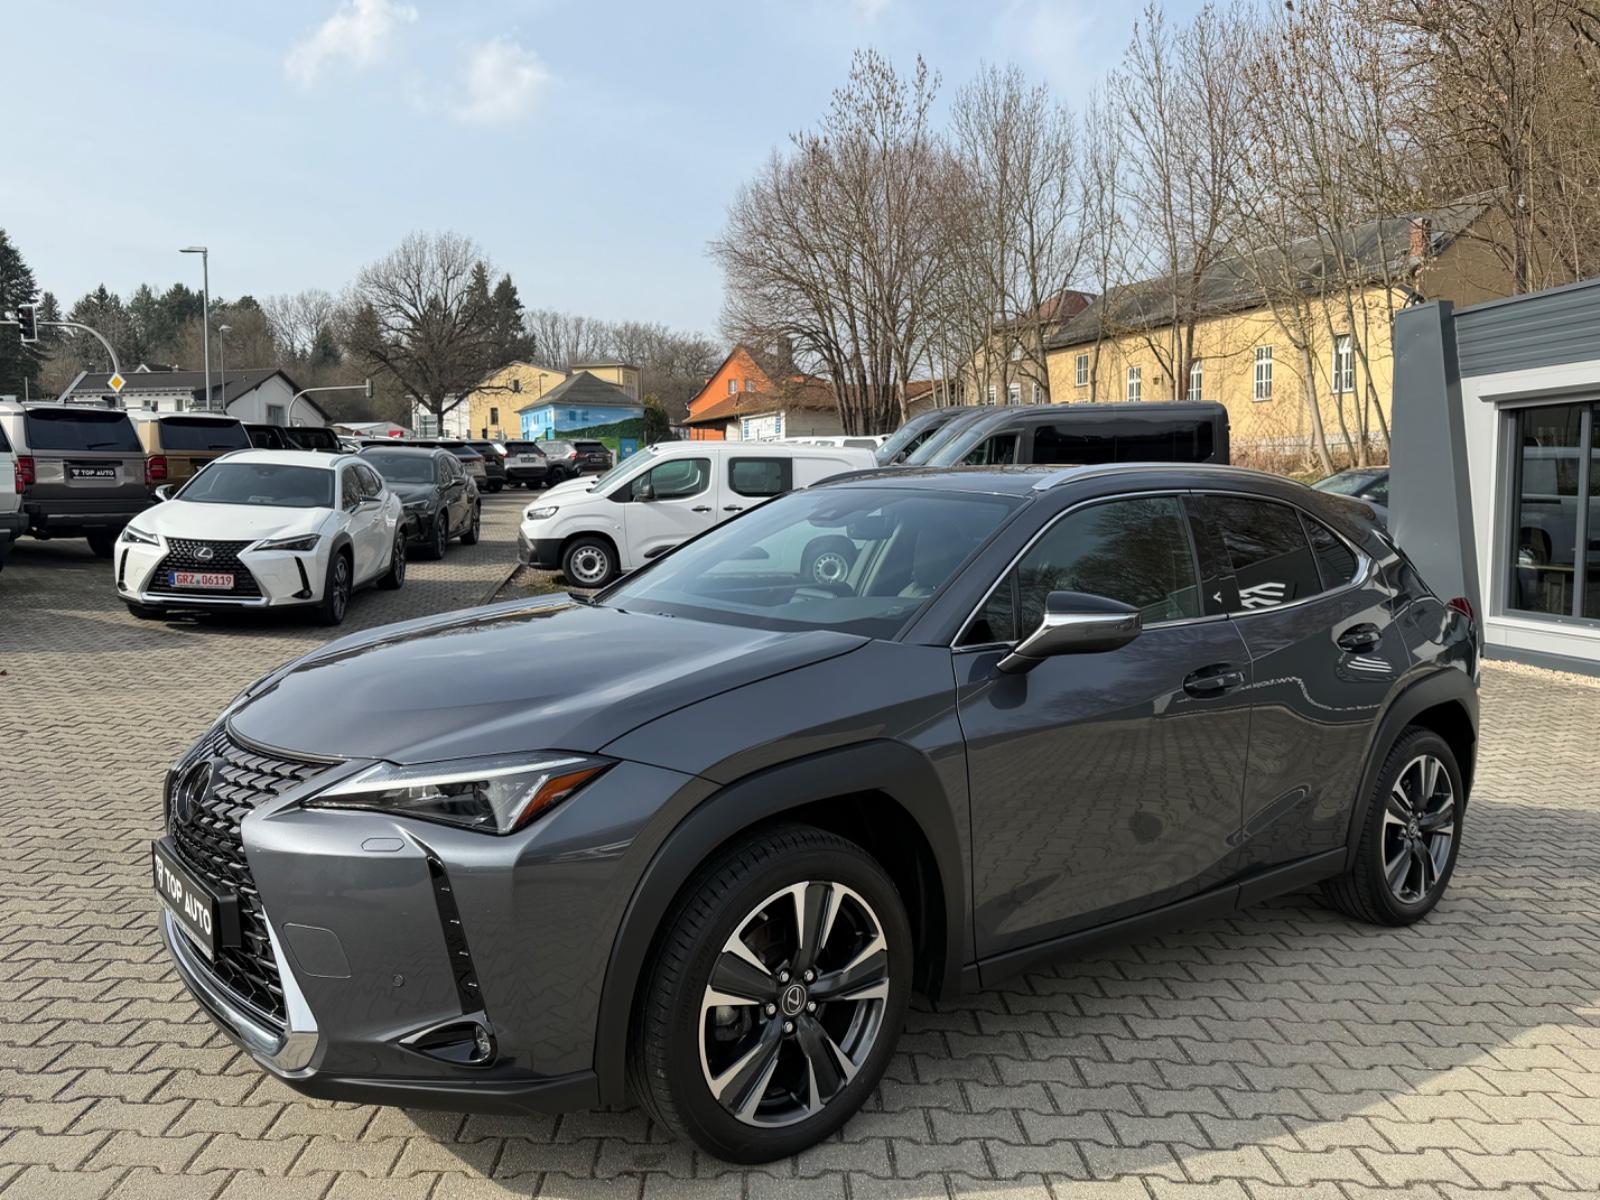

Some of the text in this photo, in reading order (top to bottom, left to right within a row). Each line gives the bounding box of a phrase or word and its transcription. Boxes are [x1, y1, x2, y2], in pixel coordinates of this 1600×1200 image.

[176, 574, 232, 586] GRZ 06119
[165, 867, 182, 903] TOP
[185, 891, 211, 935] AUTO
